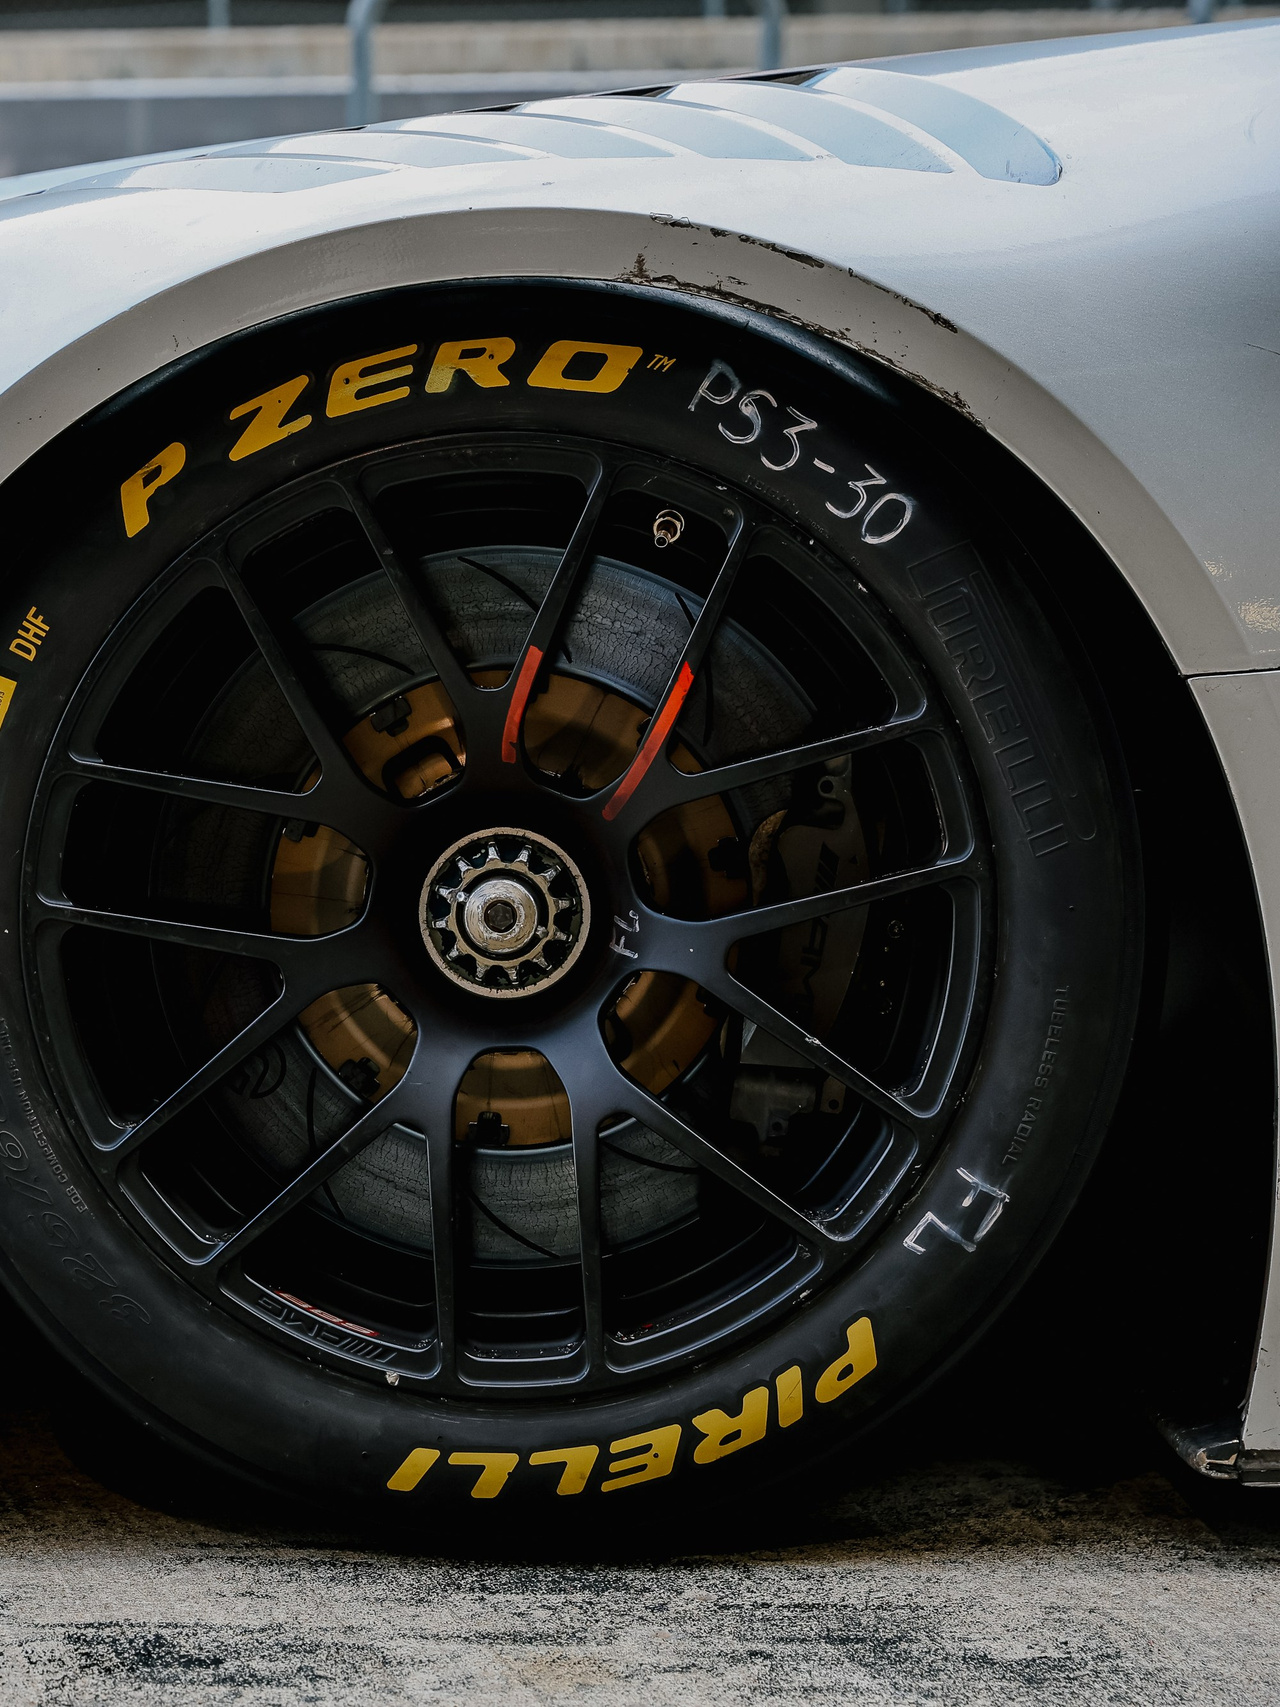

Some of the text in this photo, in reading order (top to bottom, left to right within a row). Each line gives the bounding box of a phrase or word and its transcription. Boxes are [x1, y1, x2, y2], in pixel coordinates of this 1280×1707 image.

[120, 441, 187, 539] P
[228, 336, 645, 462] ZERO
[688, 359, 917, 545] PS3-30
[9, 606, 50, 662] DHF
[906, 539, 1097, 858] PIRELLI
[19, 1090, 69, 1183] COMPETITION
[1000, 984, 1070, 1166] TUBELESS RADIAL
[66, 1185, 89, 1214] FOR
[902, 1166, 1010, 1255] FL
[386, 1316, 878, 1500] PIRELLI
